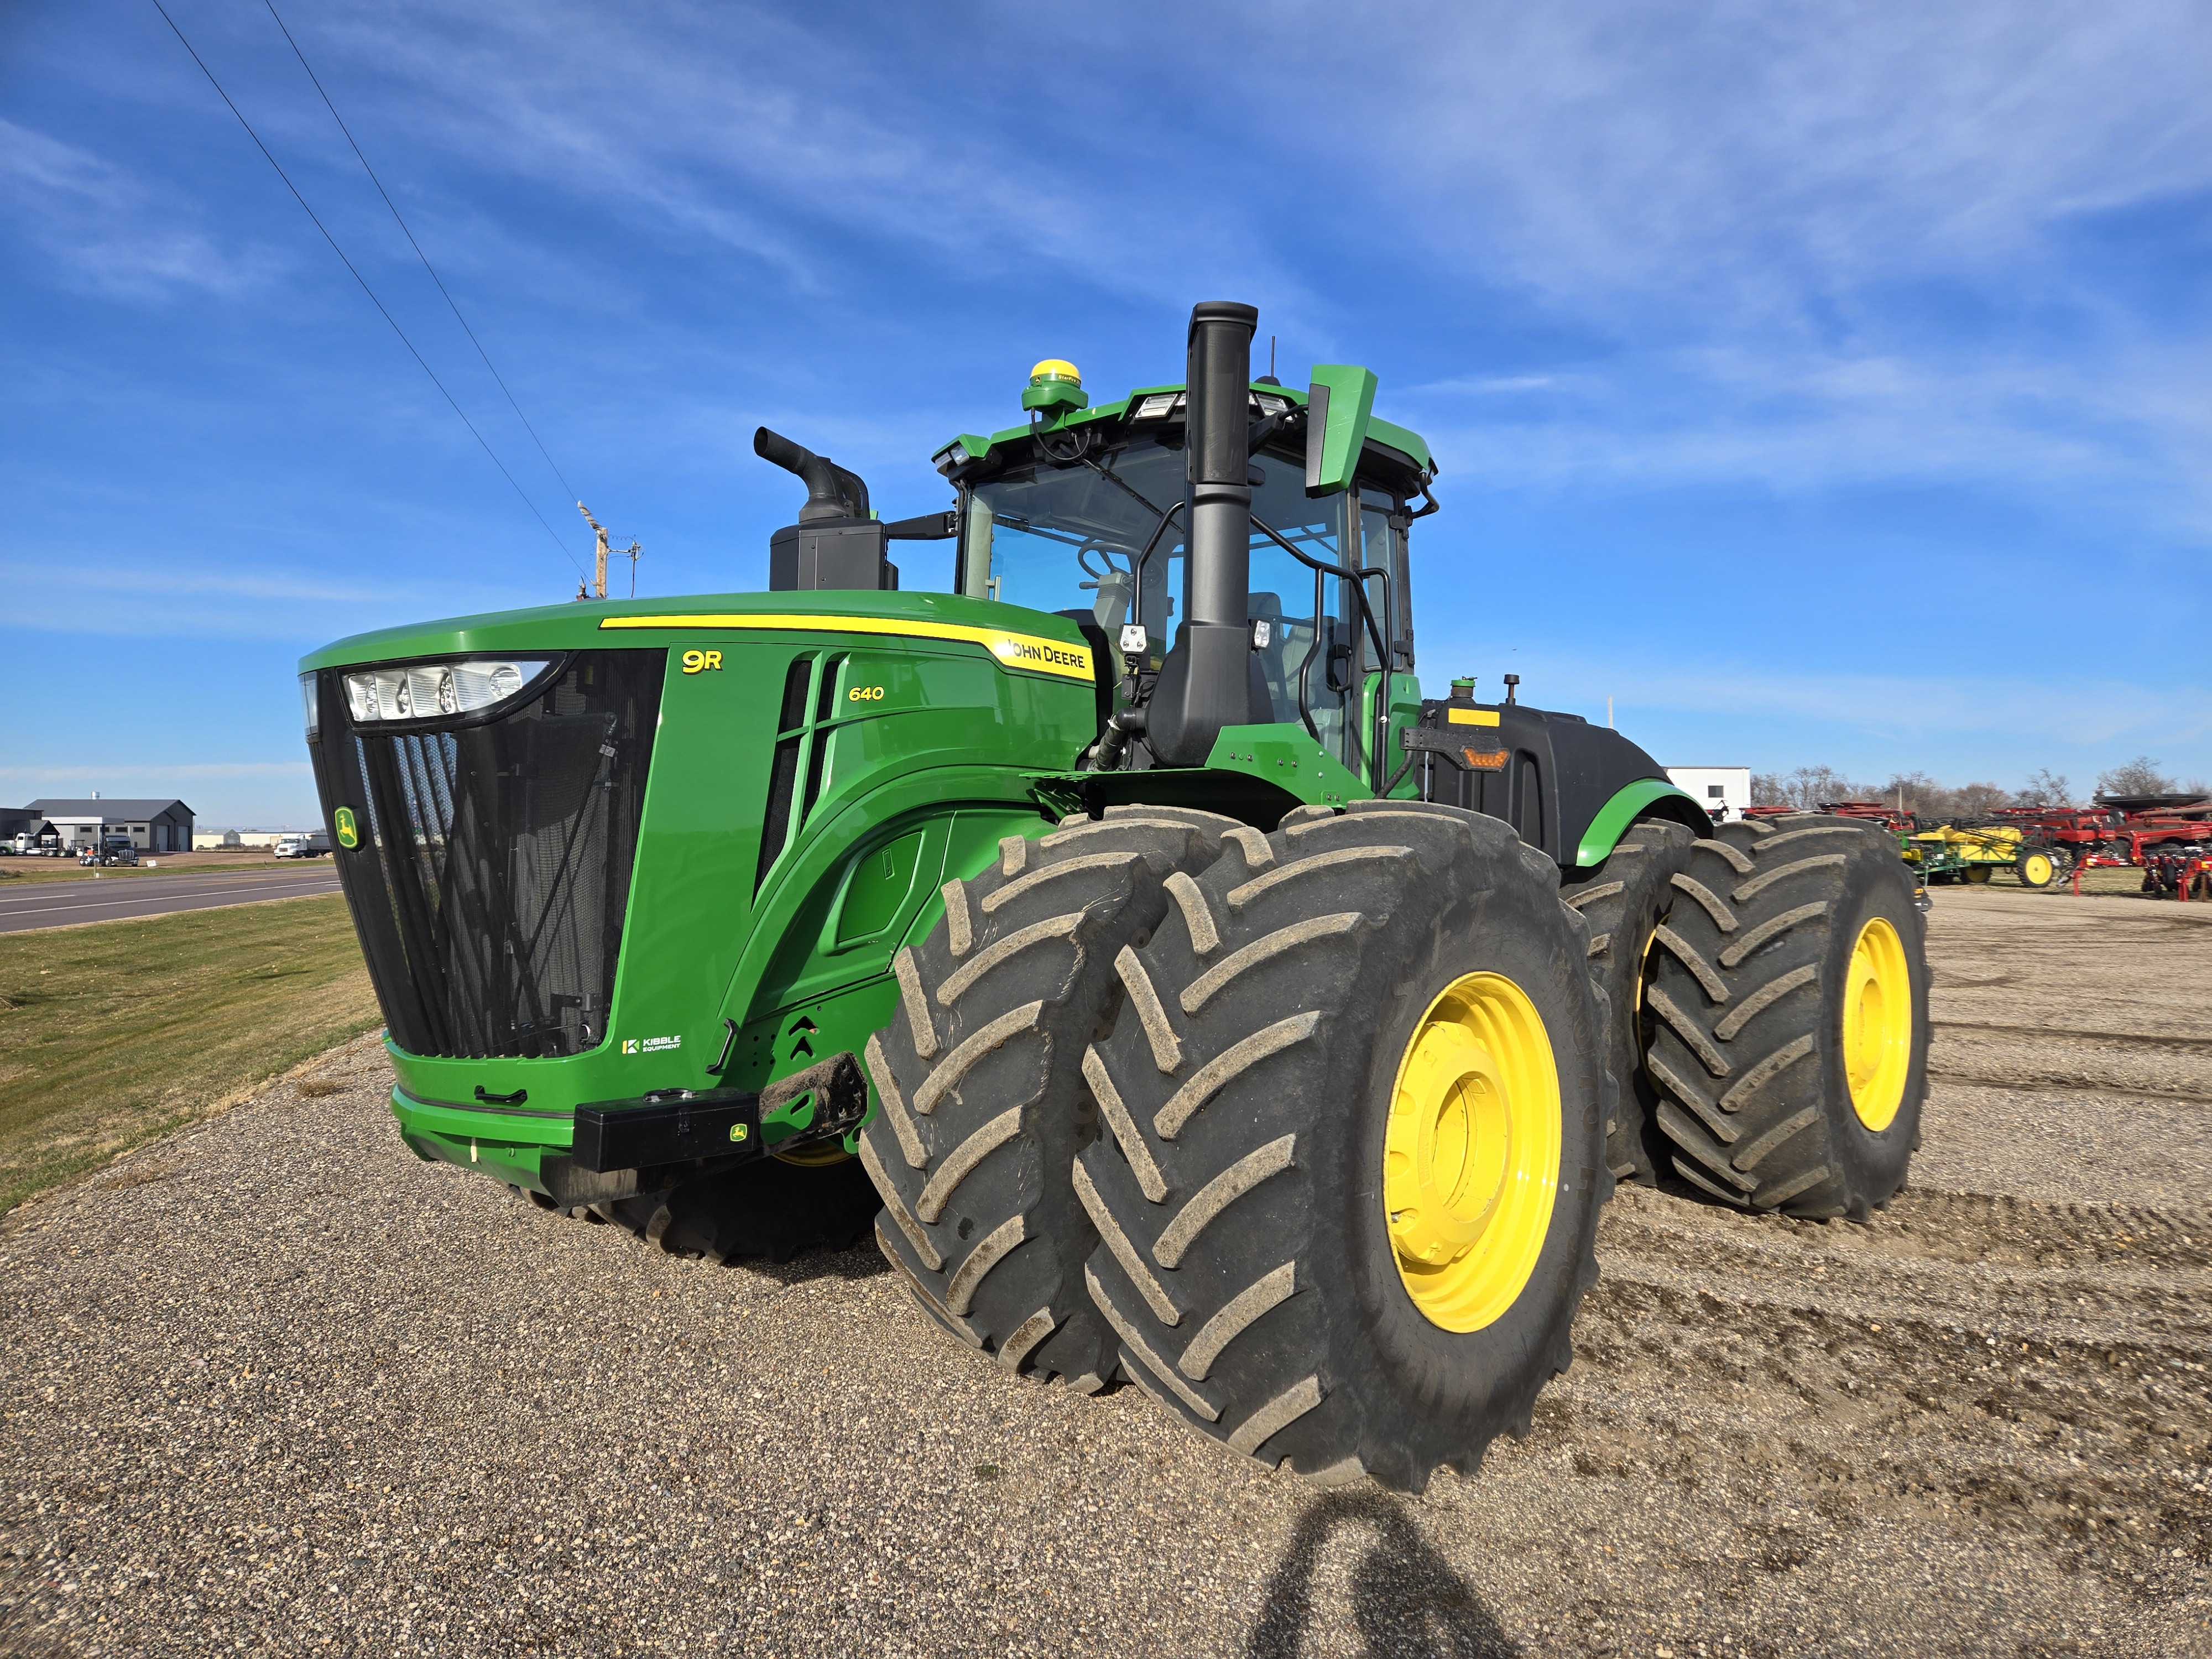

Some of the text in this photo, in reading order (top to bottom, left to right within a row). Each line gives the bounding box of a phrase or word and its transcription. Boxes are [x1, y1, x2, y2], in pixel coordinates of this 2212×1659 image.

[1058, 374, 1076, 383] StarFire
[682, 650, 723, 675] 9R
[1043, 645, 1085, 669] DEERE
[848, 686, 884, 702] 640
[643, 1035, 681, 1046] KIBBLE
[643, 1043, 681, 1052] EQUIPMENT
